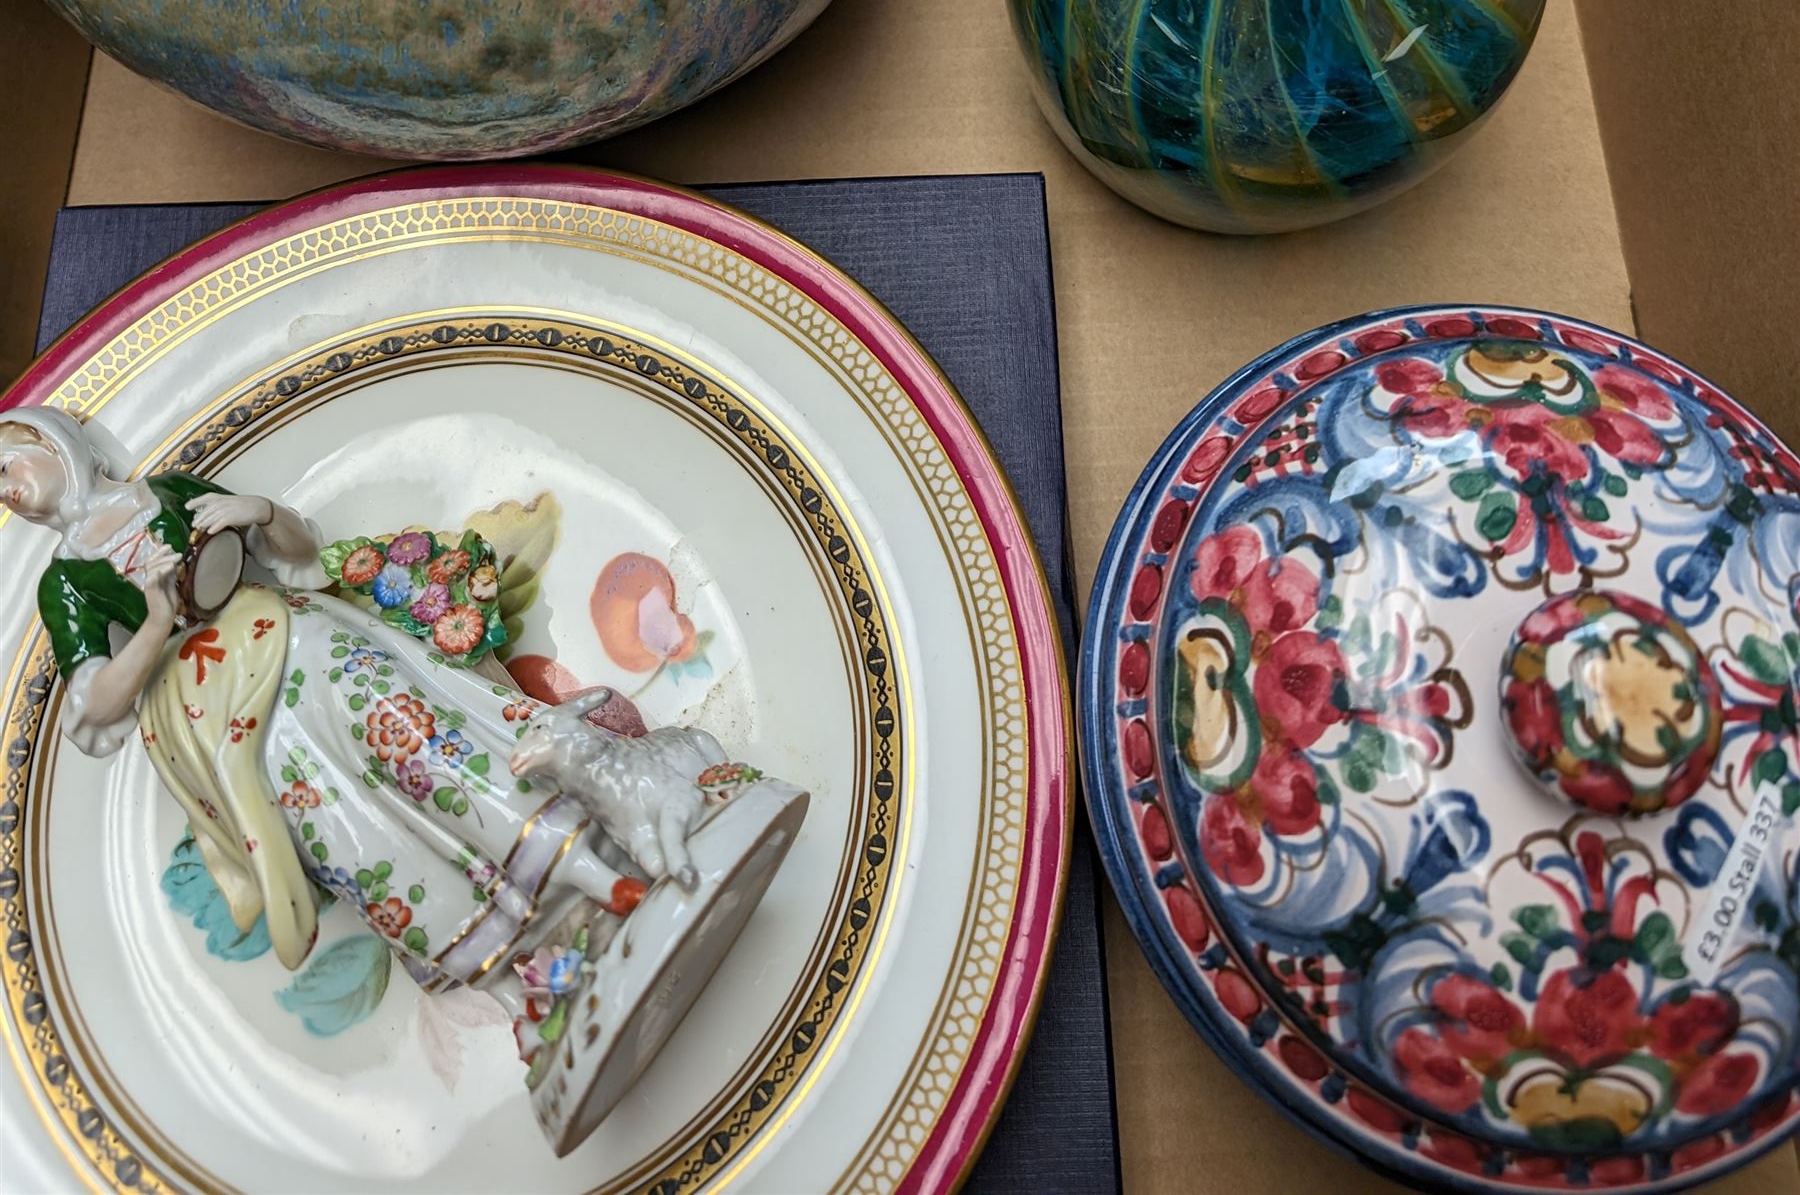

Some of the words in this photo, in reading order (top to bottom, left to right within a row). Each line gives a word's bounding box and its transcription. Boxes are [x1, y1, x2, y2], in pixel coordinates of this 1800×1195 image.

[1697, 895, 1737, 962] £3.00
[1728, 842, 1761, 896] Stall
[1749, 795, 1779, 841] 337
